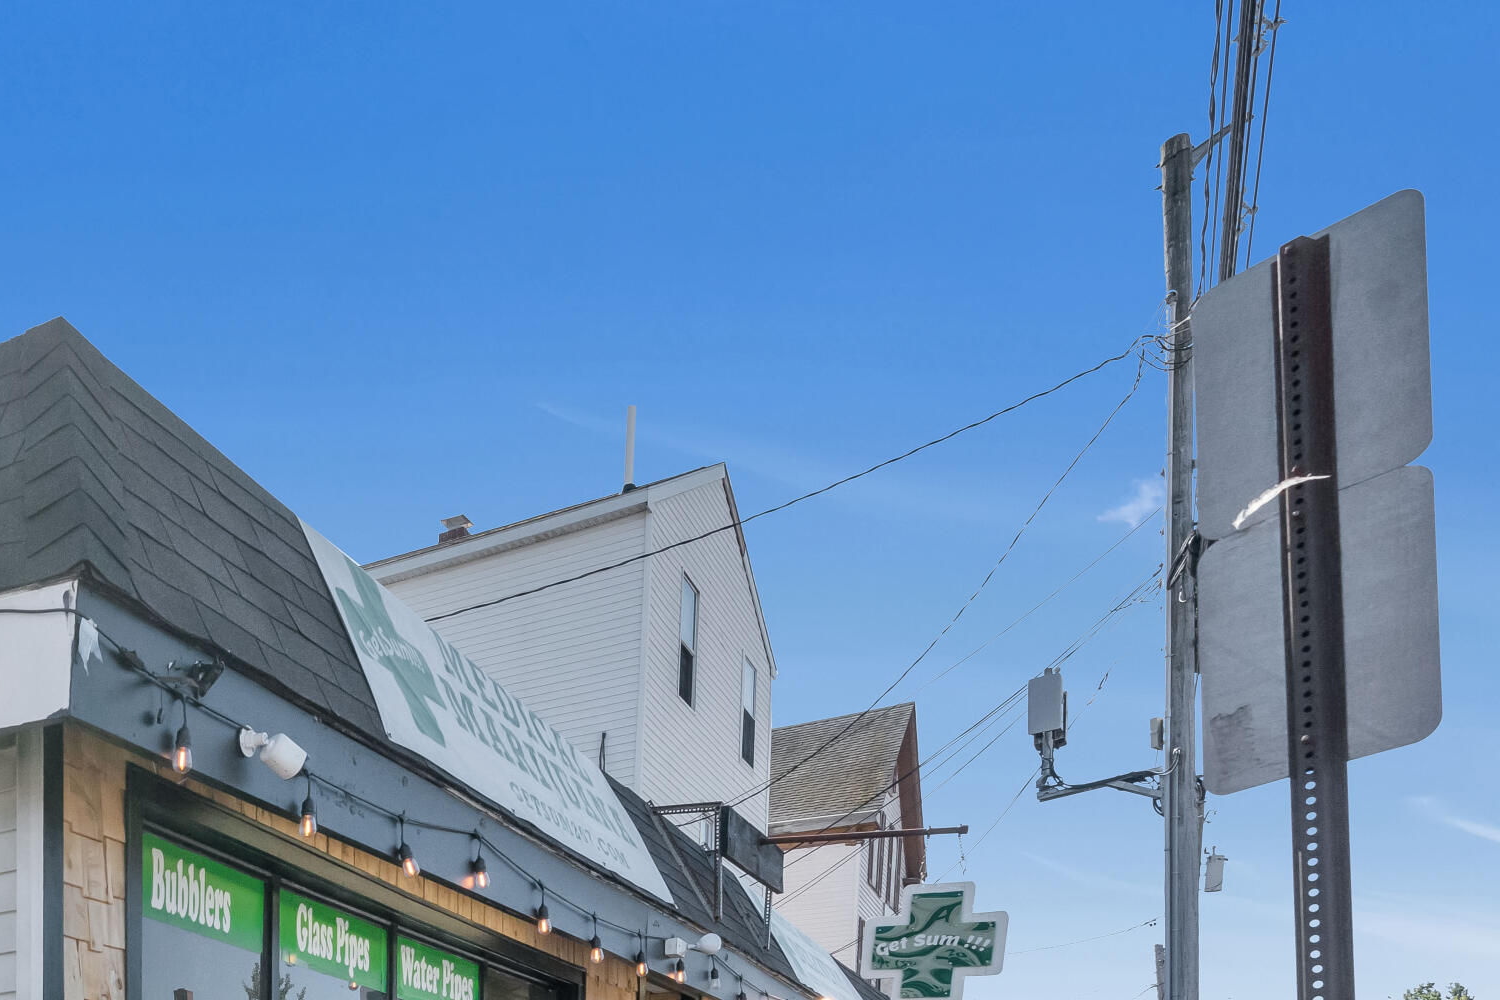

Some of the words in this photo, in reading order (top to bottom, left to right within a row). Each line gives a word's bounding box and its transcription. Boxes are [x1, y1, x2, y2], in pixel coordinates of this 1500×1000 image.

[428, 626, 594, 787] MEDICAL
[438, 674, 638, 847] MARIJUANA
[151, 847, 232, 934] Bubblers
[296, 903, 334, 962] Glass
[336, 917, 370, 979] Pipes
[876, 936, 908, 956] Get
[913, 933, 960, 947] Sum
